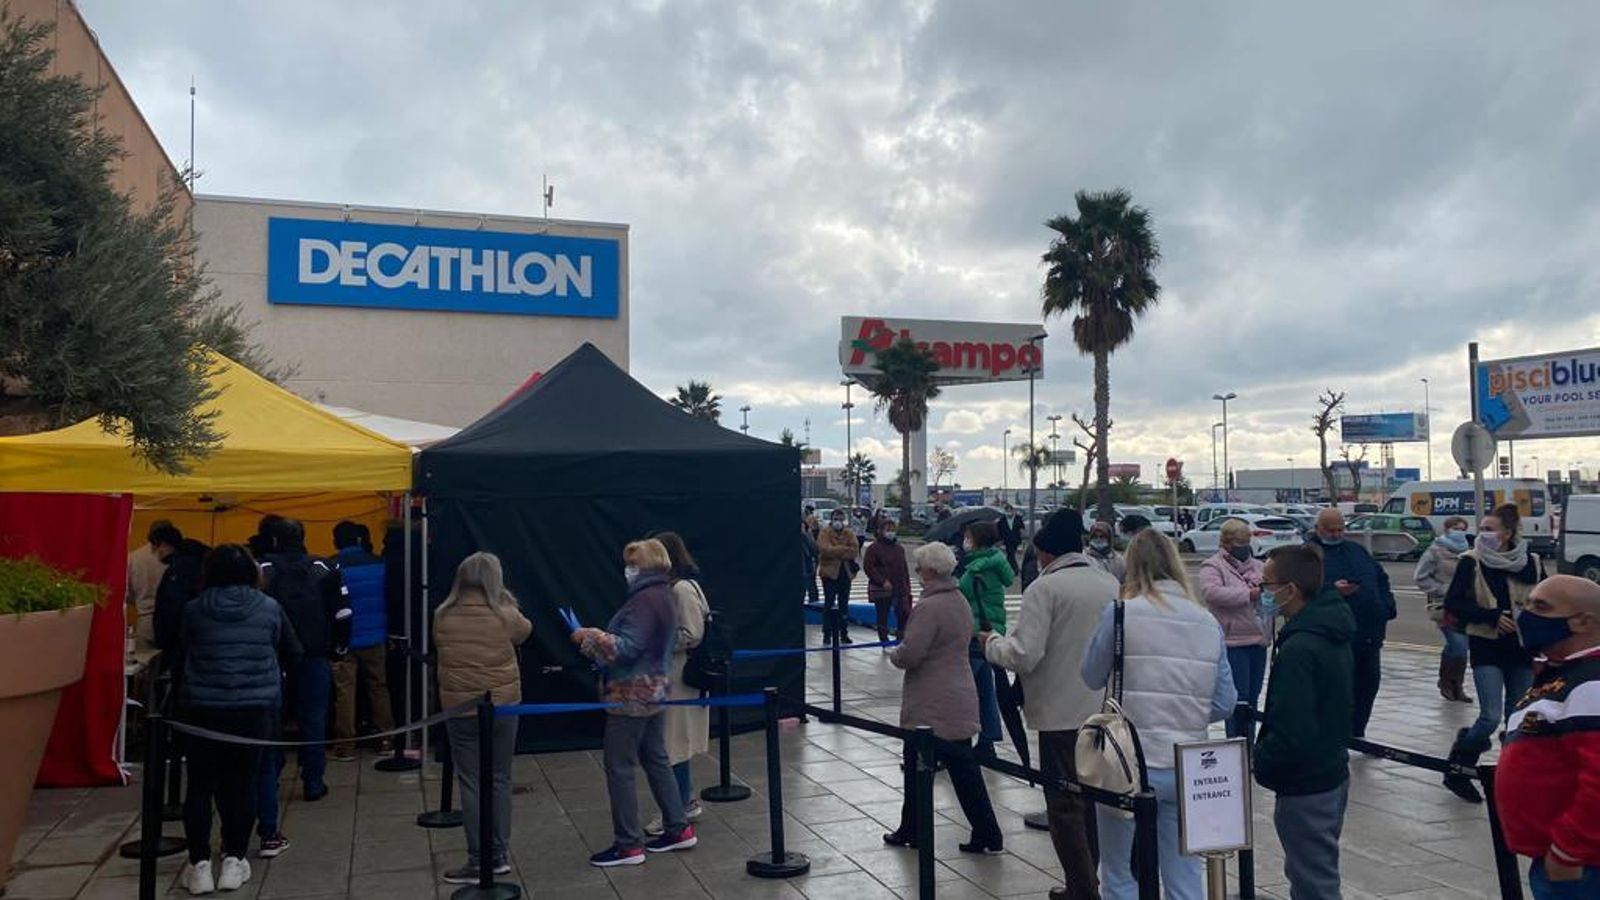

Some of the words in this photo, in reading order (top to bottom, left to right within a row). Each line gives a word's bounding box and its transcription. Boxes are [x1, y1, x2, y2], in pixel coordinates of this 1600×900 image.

[299, 238, 592, 298] DECATHLON
[850, 318, 1041, 376] Aampo
[1489, 358, 1600, 397] pisciblu
[1522, 394, 1552, 405] YOUR
[1555, 392, 1584, 402] POOL
[1434, 497, 1460, 508] DFM
[1193, 776, 1229, 787] ENTRADA
[1193, 790, 1231, 801] ENTRANCE
